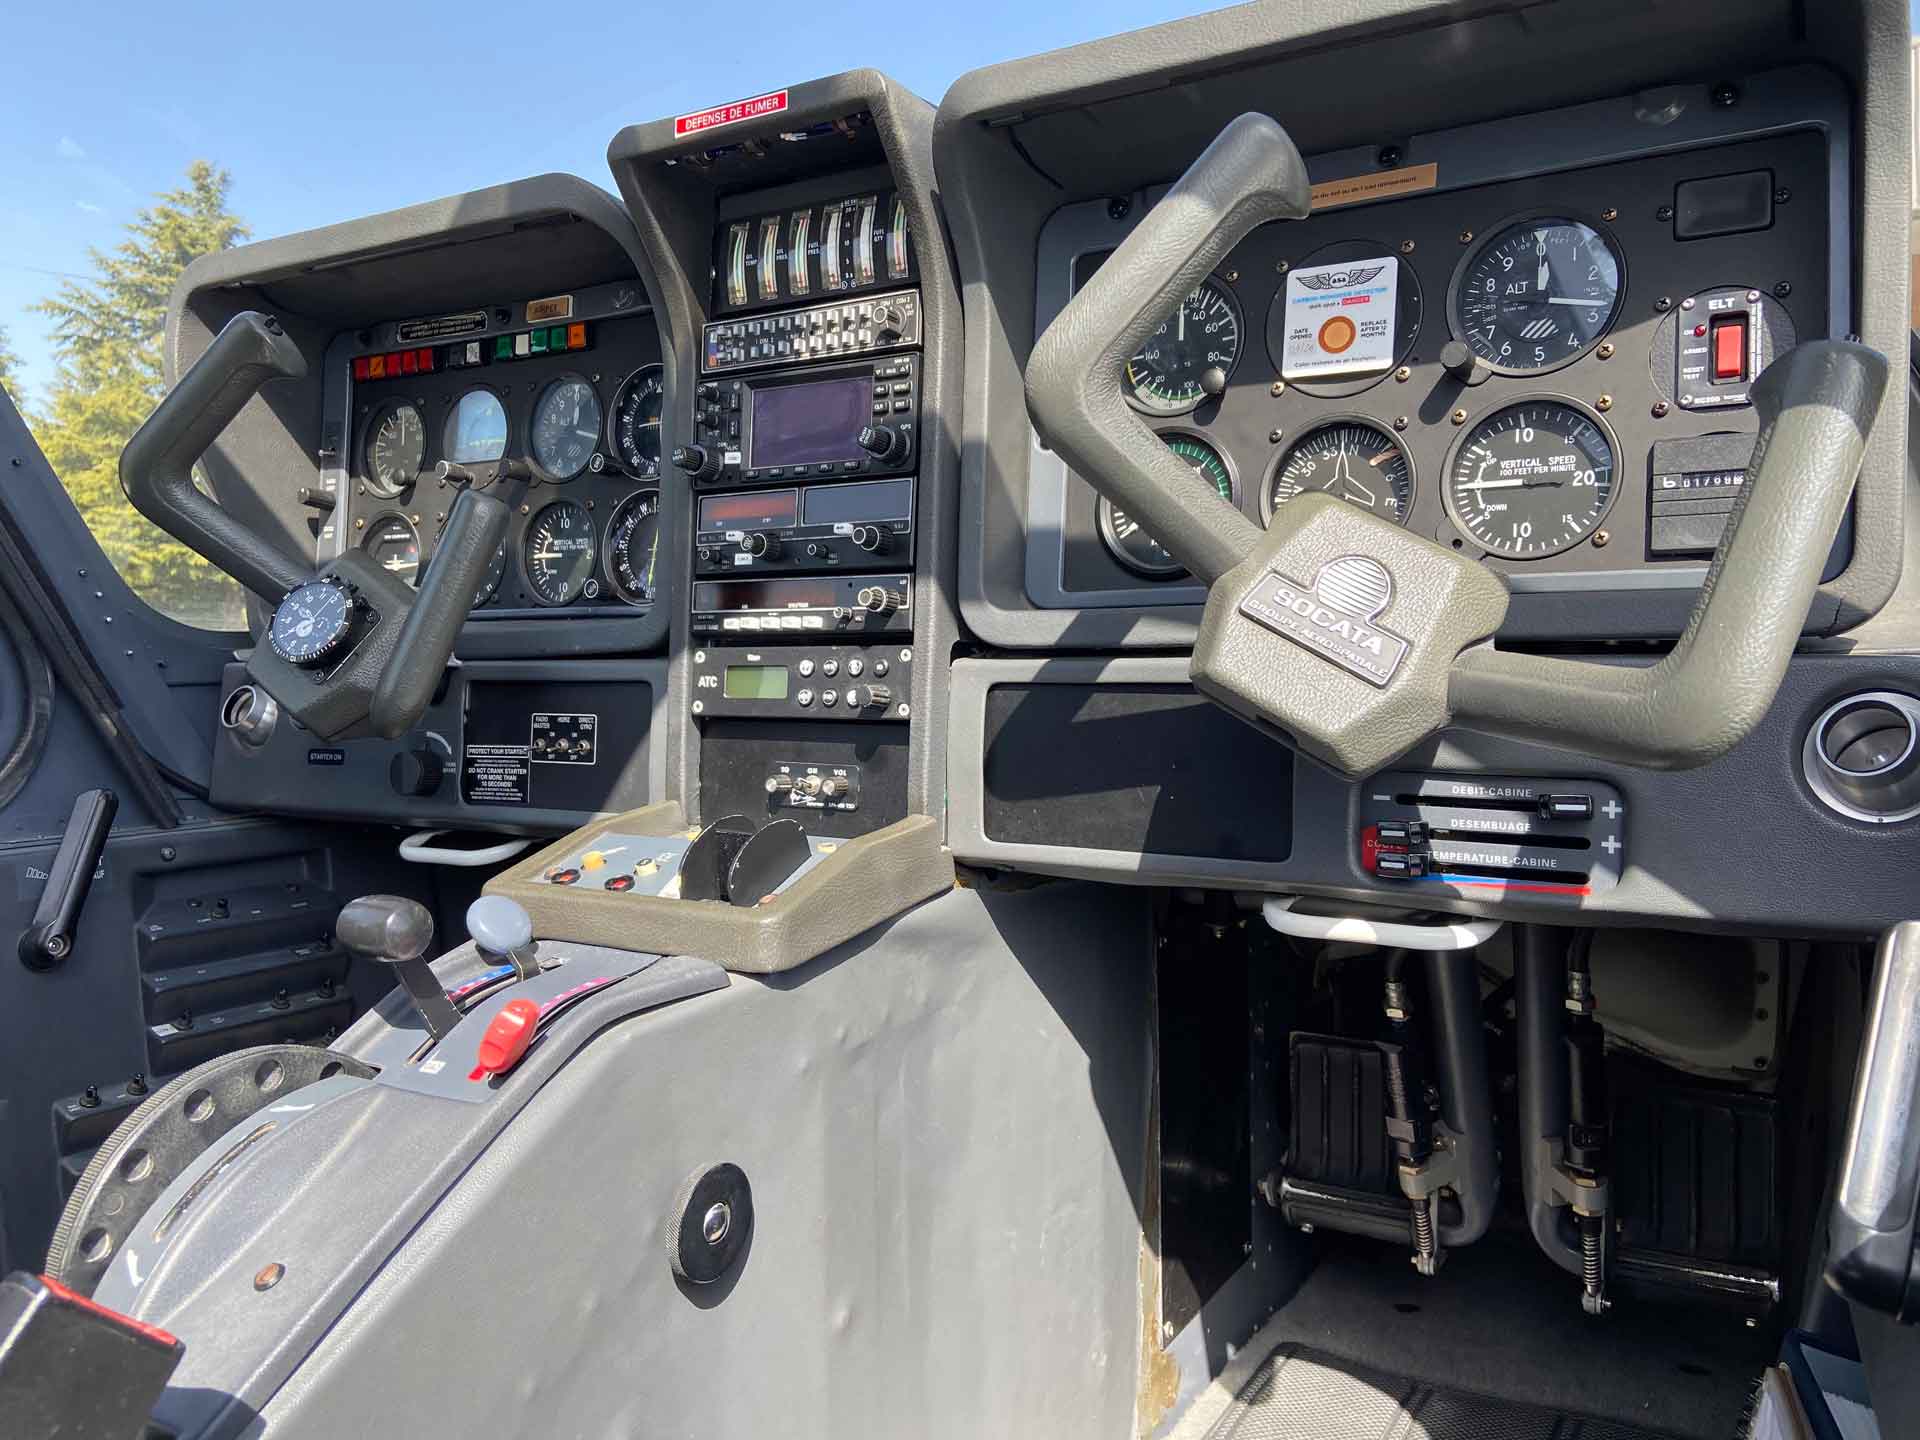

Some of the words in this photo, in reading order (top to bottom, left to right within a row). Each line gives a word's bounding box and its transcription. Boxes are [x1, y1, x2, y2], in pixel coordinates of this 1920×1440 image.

[685, 110, 727, 130] DEFENSE
[729, 106, 743, 119] DE
[745, 97, 779, 115] FUMER
[1536, 242, 1546, 256] 0
[1502, 256, 1514, 272] 9
[1588, 265, 1599, 281] 2
[1486, 278, 1496, 292] 8
[1505, 281, 1529, 296] ALT
[1708, 298, 1735, 310] ELT
[1192, 310, 1206, 321] 40
[1586, 309, 1599, 323] 3
[1205, 322, 1218, 333] 60
[1486, 325, 1496, 340] 7
[1567, 333, 1580, 347] 4
[1501, 341, 1512, 356] 6
[1534, 346, 1545, 361] 5
[1145, 350, 1160, 361] 140
[1207, 351, 1220, 362] 80
[1515, 428, 1534, 443] 10
[1564, 435, 1575, 444] 15
[1322, 446, 1338, 460] 33
[1350, 444, 1360, 456] N
[1486, 450, 1493, 459] 5
[1486, 457, 1497, 465] UP
[1500, 457, 1542, 469] VERTICAL
[1548, 455, 1577, 466] SPEED
[1300, 461, 1317, 478] 30
[1500, 468, 1513, 476] 100
[1513, 466, 1533, 476] FEET
[1534, 465, 1549, 474] PER
[1550, 463, 1577, 472] MINUTE
[1385, 473, 1397, 482] 6
[1572, 470, 1596, 487] 20
[640, 502, 648, 513] W
[1384, 497, 1398, 508] E
[1486, 504, 1507, 512] DOWN
[1483, 511, 1491, 520] 5
[1562, 514, 1573, 523] 15
[560, 518, 570, 529] 10
[1512, 522, 1532, 538] 10
[554, 538, 573, 546] VERTICAL
[559, 582, 568, 592] 10
[1272, 587, 1384, 656] SOCATA
[1248, 598, 1298, 631] GROUPE
[1301, 628, 1389, 678] AEROSPATIALE
[698, 676, 718, 688] ATC
[580, 723, 593, 731] GYRO
[310, 752, 333, 761] STARTER
[1452, 785, 1533, 798] DEBIT-CABINE
[1450, 819, 1532, 832] DESEMBUAGE
[1430, 850, 1558, 868] TEMPERATURE-CABINE
